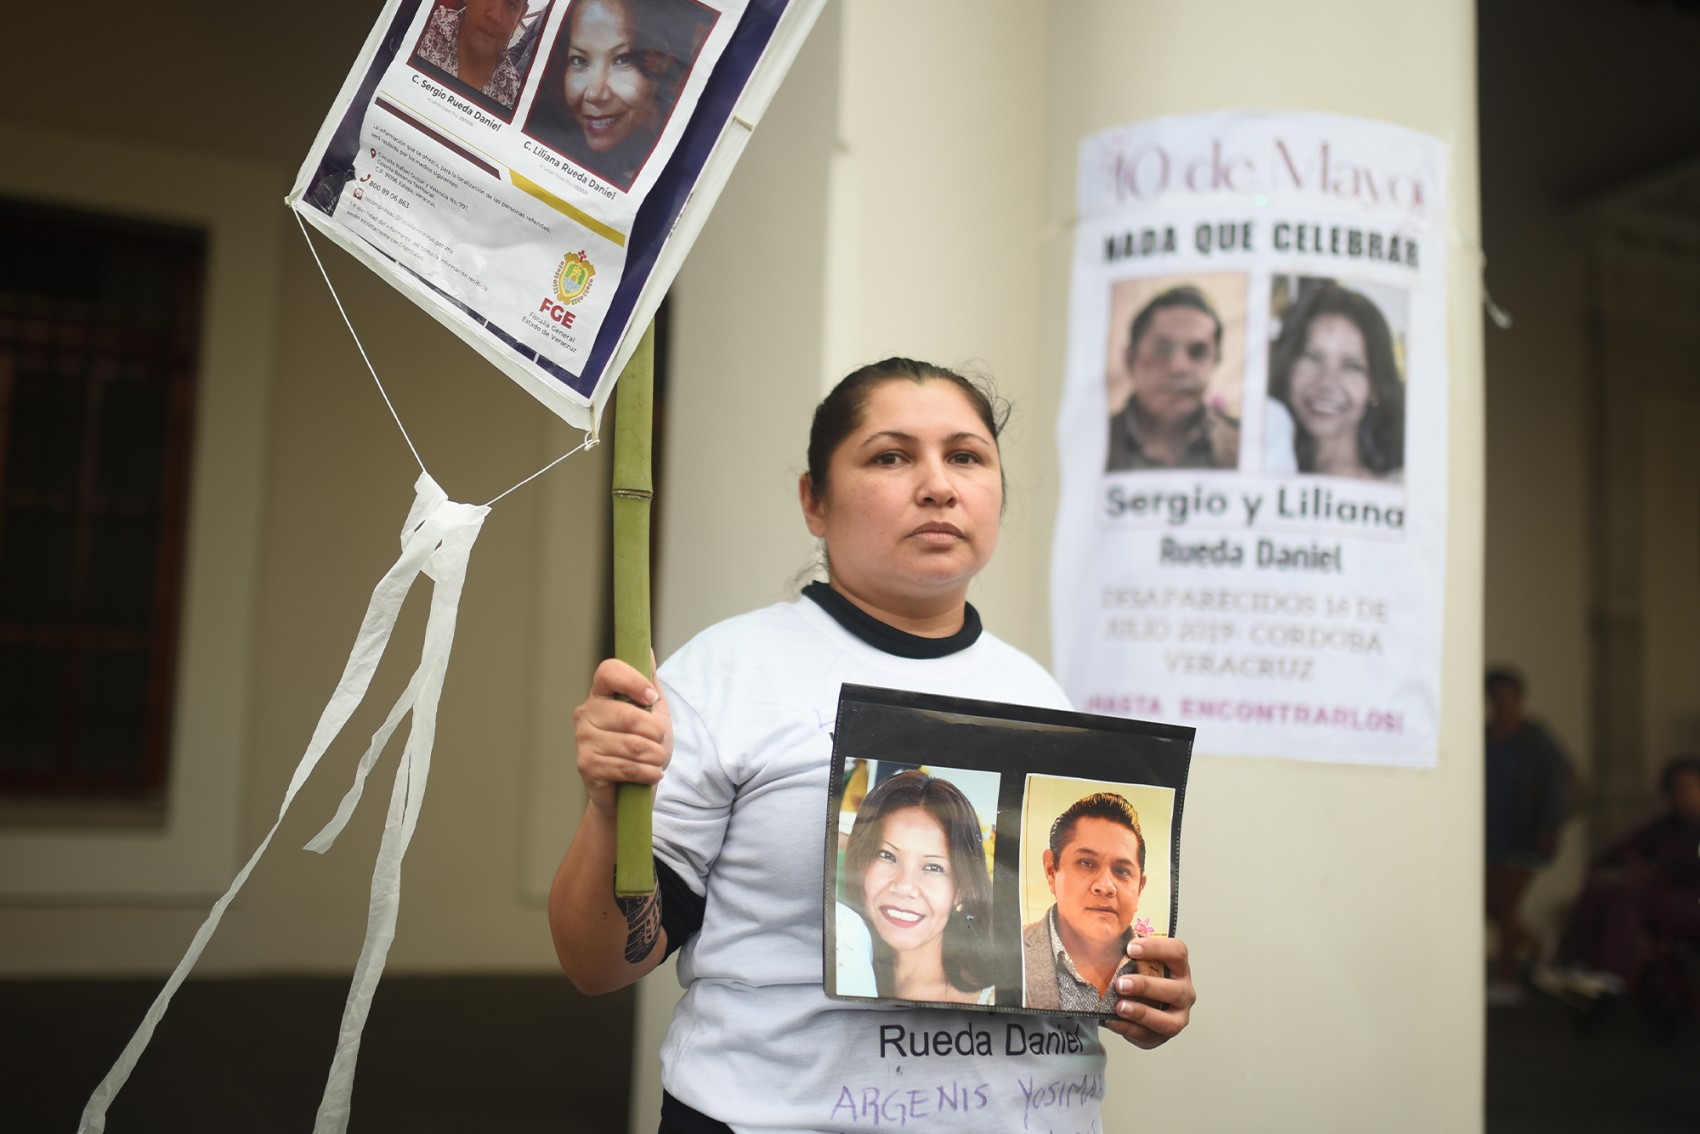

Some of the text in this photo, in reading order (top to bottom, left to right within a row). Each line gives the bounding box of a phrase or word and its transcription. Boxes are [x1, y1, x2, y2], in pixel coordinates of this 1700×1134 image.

[410, 74, 502, 132] C. Sergio Rueda Daniel
[405, 144, 416, 153] que
[484, 191, 493, 200] de
[500, 201, 526, 219] personas
[522, 140, 616, 200] C. Liliana Rueda Daniel
[1185, 137, 1257, 194] de
[368, 180, 410, 209] 800 89 06 863
[1105, 221, 1420, 269] NADA QUE CELEBRAR
[537, 297, 577, 329] FGE
[520, 315, 577, 353] Estado de Veracruz
[550, 324, 576, 343] General
[1105, 484, 1406, 531] Sergio y Liliana
[1160, 536, 1344, 573] Rueda Daniel
[1102, 585, 1317, 617] DESAPARECIDOS
[1356, 595, 1389, 624] DE
[1104, 614, 1171, 643] JULIO
[1162, 650, 1316, 681] VERACRUZ
[880, 1022, 1084, 1058] Rueda Daniel
[830, 1081, 991, 1127] ARGENIS
